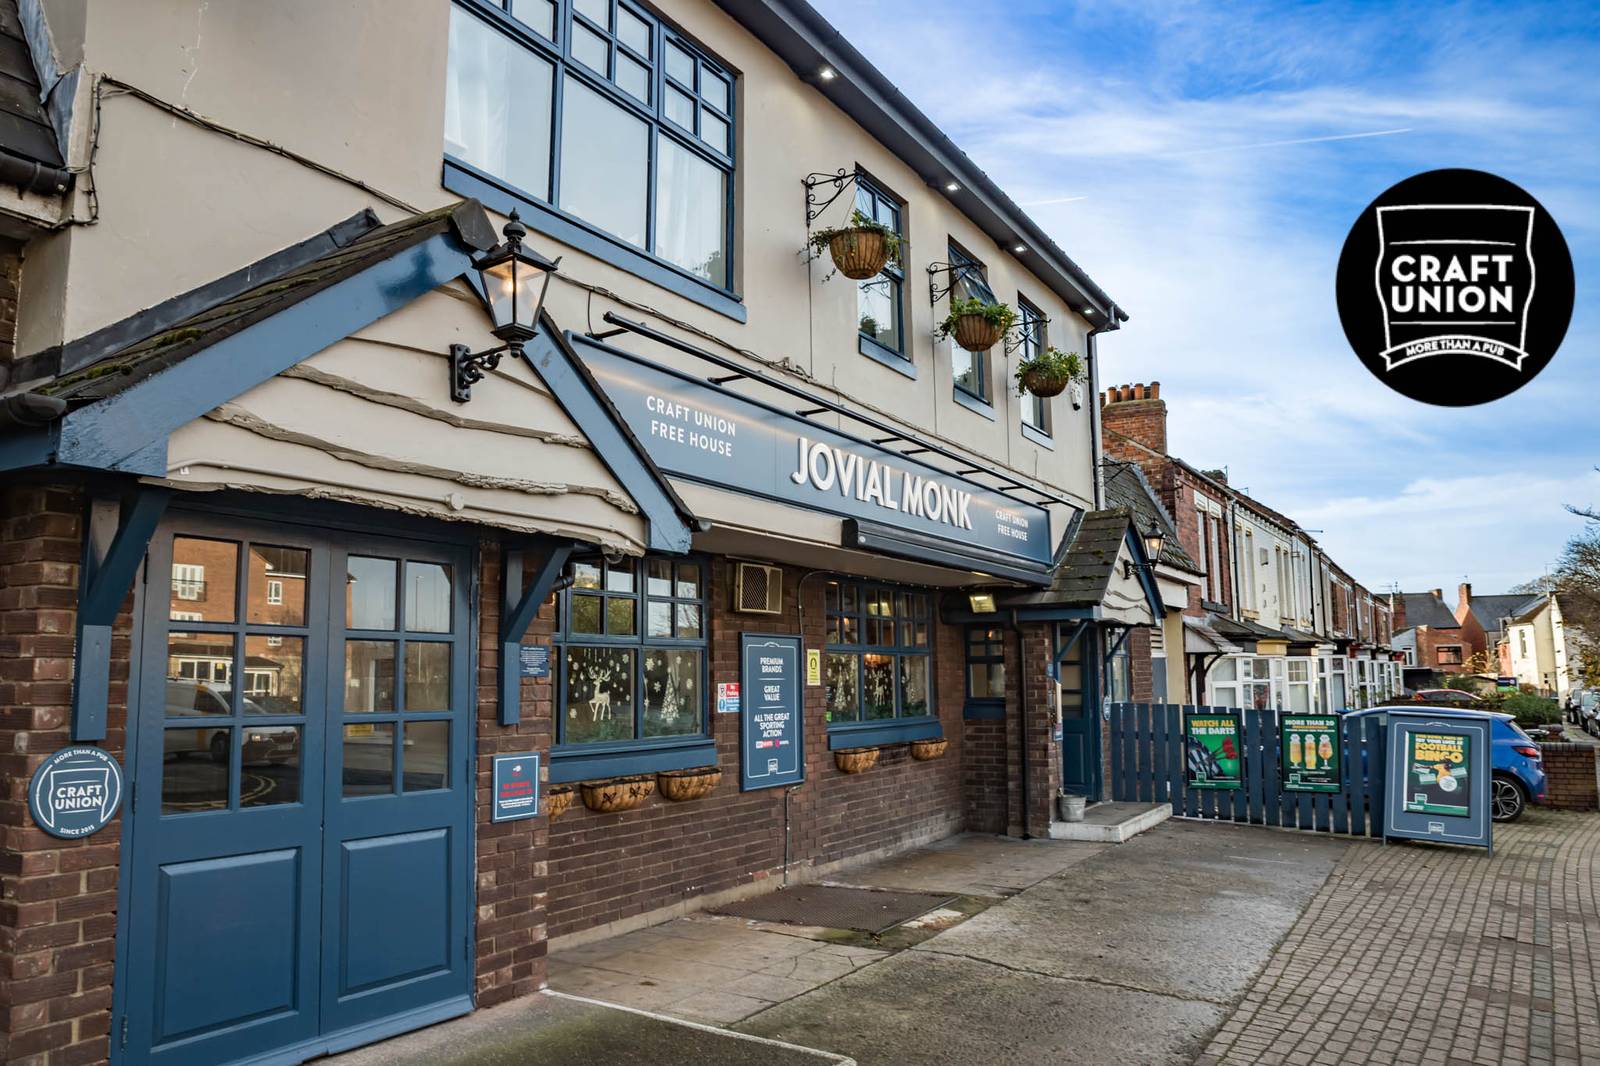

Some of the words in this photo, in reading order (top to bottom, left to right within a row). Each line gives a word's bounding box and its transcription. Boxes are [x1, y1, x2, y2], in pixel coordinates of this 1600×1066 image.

[646, 395, 690, 422] CRAFT
[694, 410, 736, 437] UNION
[651, 419, 685, 444] FREE
[689, 431, 732, 457] HOUSE
[790, 436, 898, 510] JOVIAL
[901, 471, 973, 530] MONK
[995, 510, 1012, 523] CRAFT
[1012, 515, 1028, 528] UNION
[998, 523, 1010, 536] FREE
[1011, 527, 1028, 541] HOUSE
[760, 657, 784, 665] PREMIUM
[761, 665, 783, 673] BRANDS
[764, 685, 780, 693] GREAT
[764, 693, 780, 701] VALUE
[754, 714, 764, 722] ALL
[764, 713, 774, 721] THE
[774, 712, 790, 720] GREAT
[760, 721, 785, 730] SPORTING
[1191, 727, 1207, 735] THE
[1208, 727, 1236, 735] DARTS
[762, 729, 782, 738] ACTION
[1415, 742, 1463, 752] FOOTBALL
[54, 752, 73, 763] MORE
[96, 752, 109, 761] PUB
[1415, 749, 1464, 763] BINGO
[56, 785, 103, 798] CRAFT
[54, 796, 103, 810] UNION
[60, 827, 79, 835] SINCE
[80, 824, 95, 834] 2015
